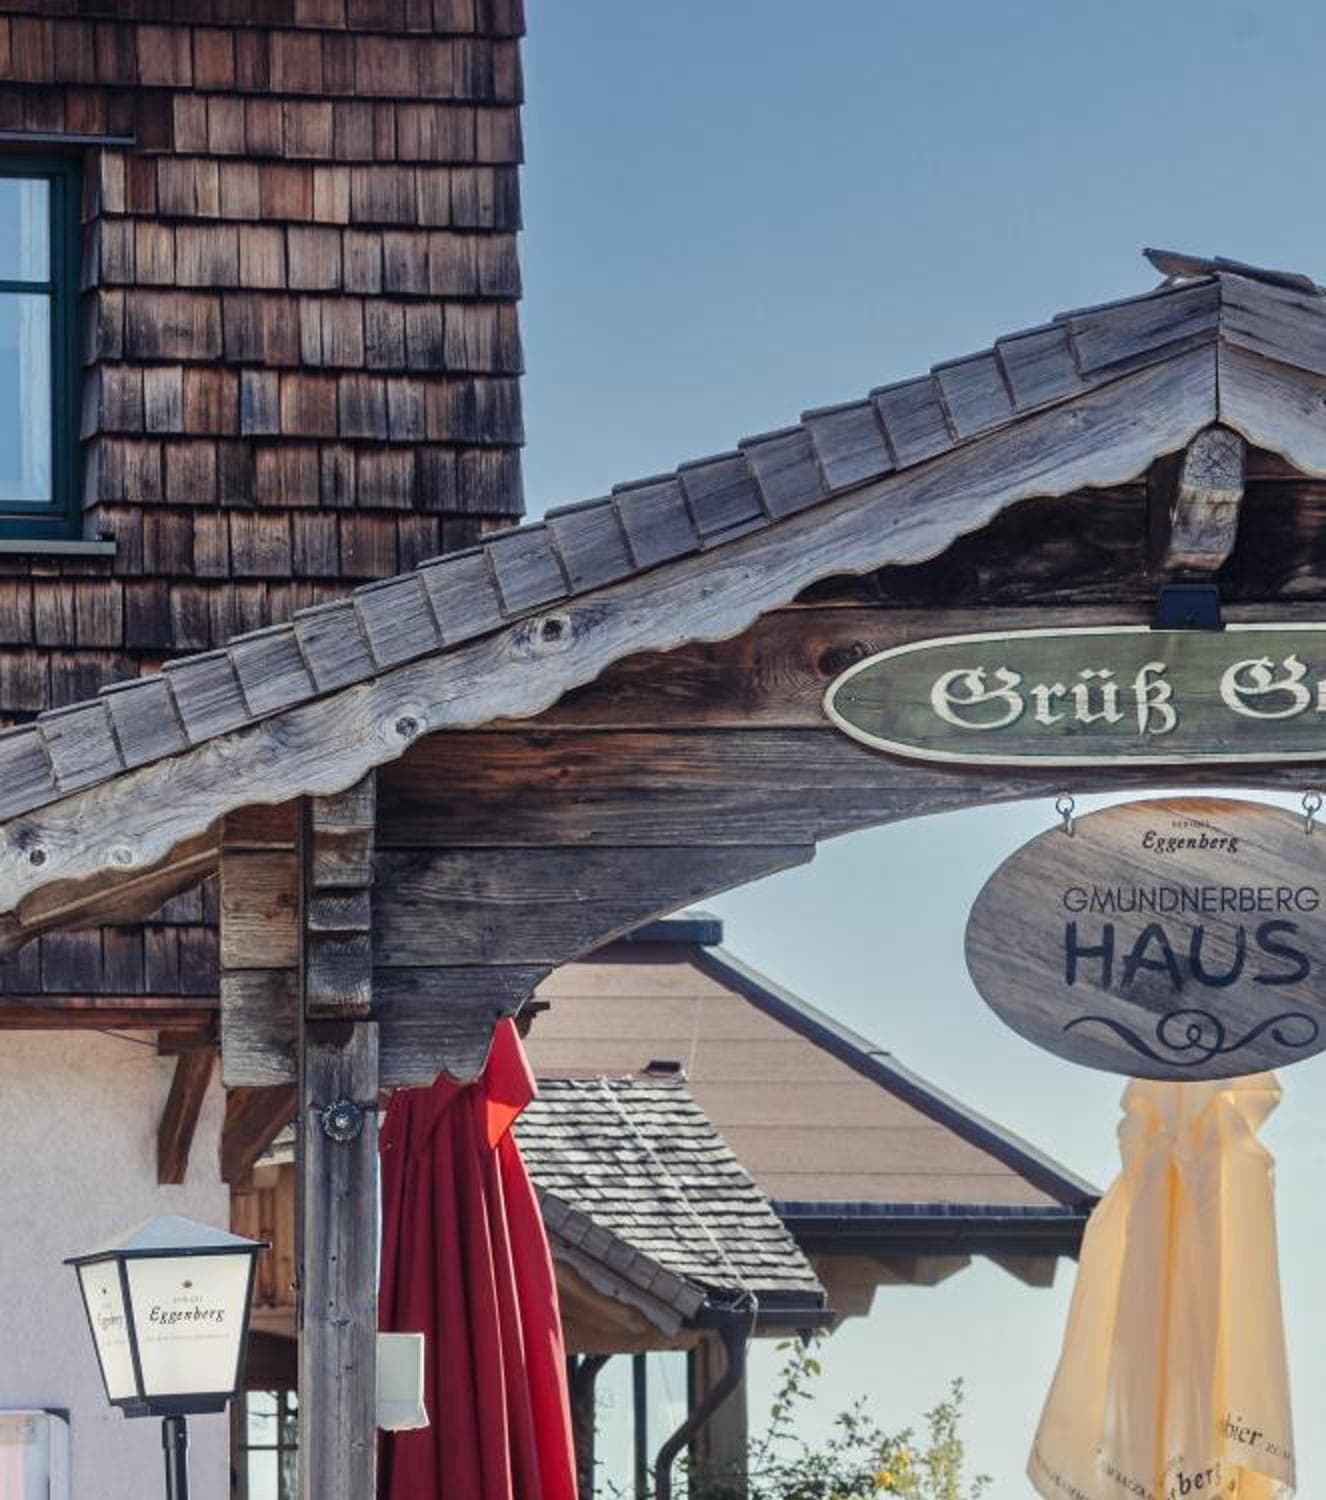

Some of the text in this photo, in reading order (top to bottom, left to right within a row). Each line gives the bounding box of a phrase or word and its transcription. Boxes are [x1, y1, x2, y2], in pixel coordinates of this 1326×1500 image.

[931, 662, 1178, 736] Grüß
[1142, 829, 1239, 854] Eggenberg
[1063, 886, 1320, 913] GMUNDNERBERG
[1065, 918, 1311, 993] HAUS
[149, 1305, 225, 1325] Eggenberg
